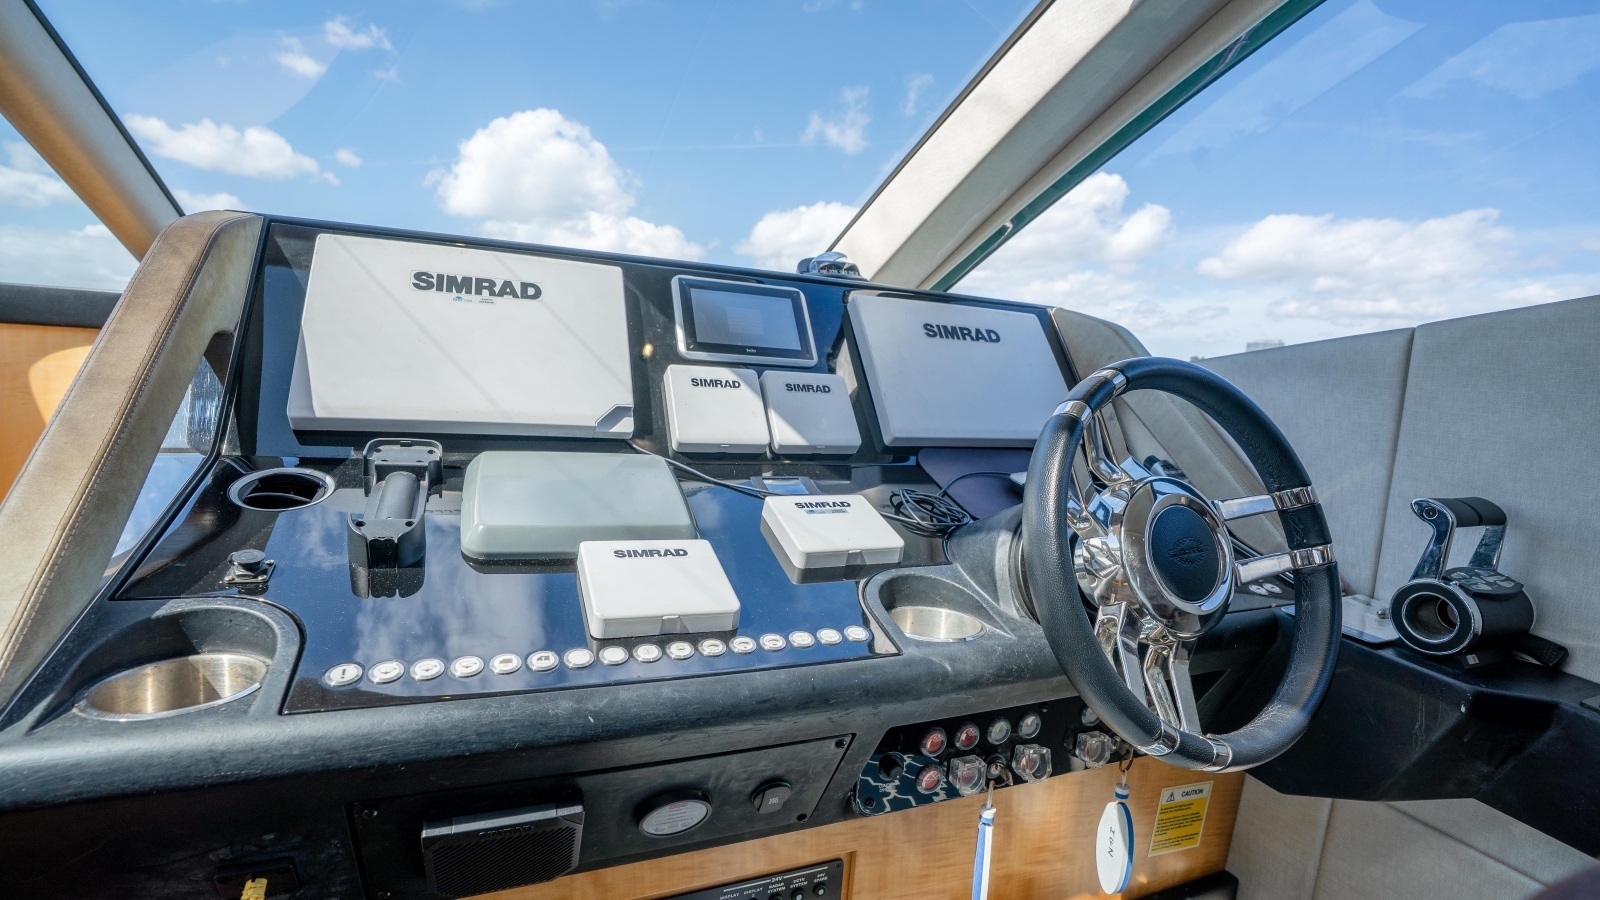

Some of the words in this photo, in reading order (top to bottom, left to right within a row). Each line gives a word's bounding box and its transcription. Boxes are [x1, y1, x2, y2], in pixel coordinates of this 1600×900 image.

[412, 271, 542, 300] SIMRAD
[923, 323, 1001, 343] SIMRAD
[691, 378, 741, 389] SIMRAD
[785, 383, 831, 394] SIMRAD
[794, 501, 852, 509] SIMRAD
[613, 548, 689, 558] SIMRAD
[1181, 788, 1204, 797] CAUTION
[743, 887, 763, 895] DISPLAY
